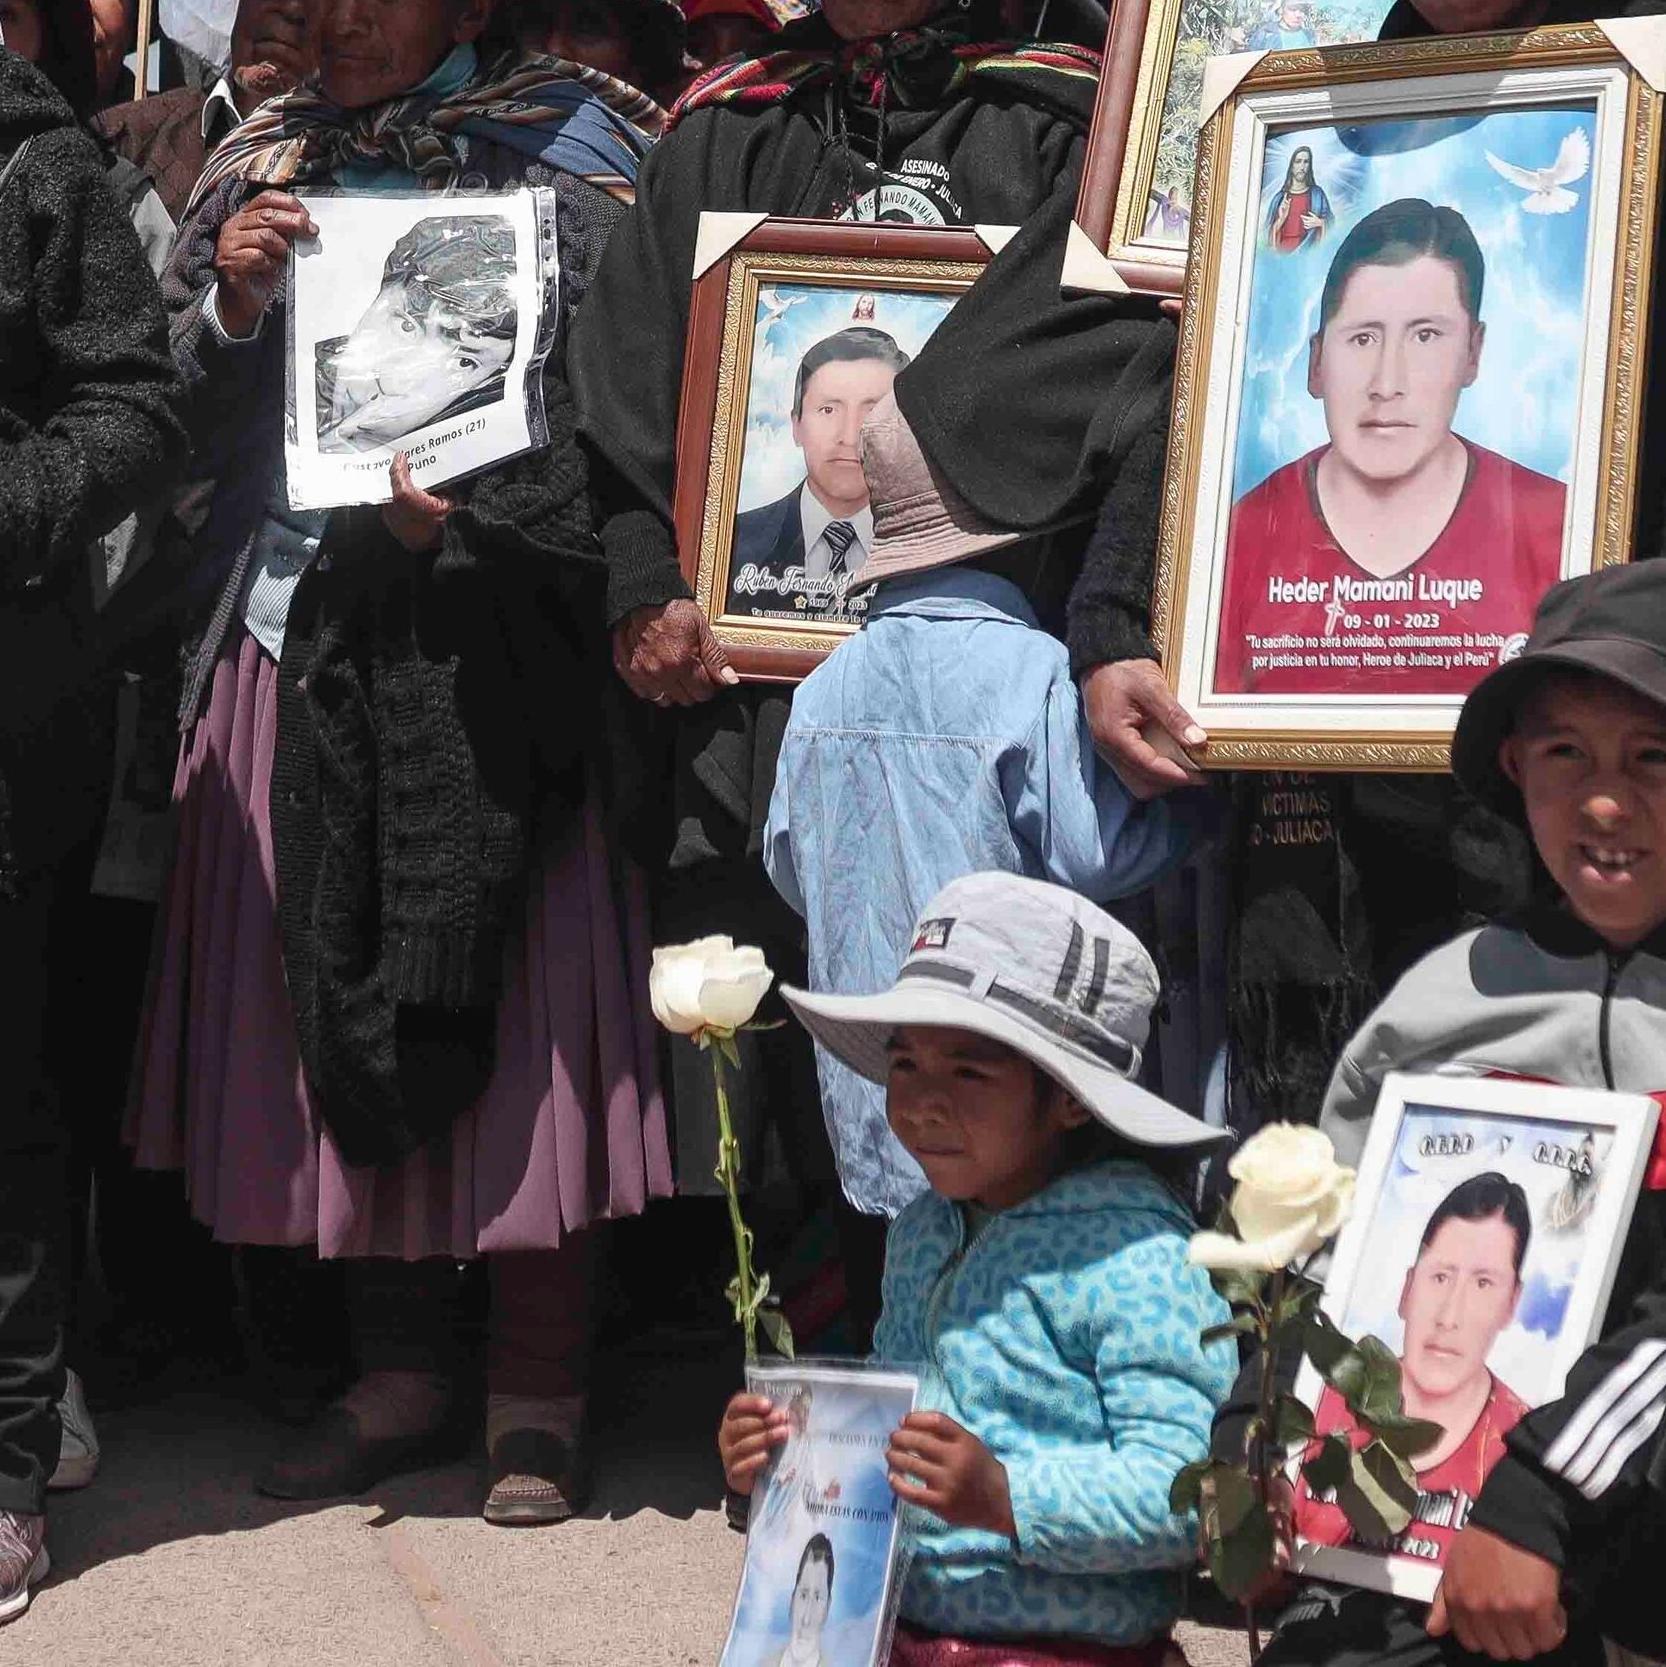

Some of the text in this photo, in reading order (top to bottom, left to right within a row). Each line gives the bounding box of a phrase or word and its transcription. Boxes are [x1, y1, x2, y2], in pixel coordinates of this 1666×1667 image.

[900, 159, 950, 182] ASESINADO
[863, 191, 909, 210] FENANDO
[428, 427, 463, 450] Ramos
[465, 418, 487, 435] (21)
[734, 562, 778, 595] Ruben
[777, 565, 835, 595] Fernando
[1268, 573, 1483, 609] Heder Mamani Luque
[763, 609, 806, 620] queremos
[1343, 613, 1362, 629] 09
[1374, 613, 1392, 629] 01
[1404, 613, 1440, 630] 2023
[1245, 634, 1261, 649] "Tu
[1262, 634, 1304, 649] sacrificio
[1305, 636, 1319, 649] no
[1320, 634, 1342, 649] será
[1342, 633, 1387, 650] olvidado,
[1388, 633, 1463, 649] continuaremos
[1464, 633, 1474, 648] la
[1252, 651, 1496, 671] por justicia en tu honor, Heroe de Juliaca y el Perú"
